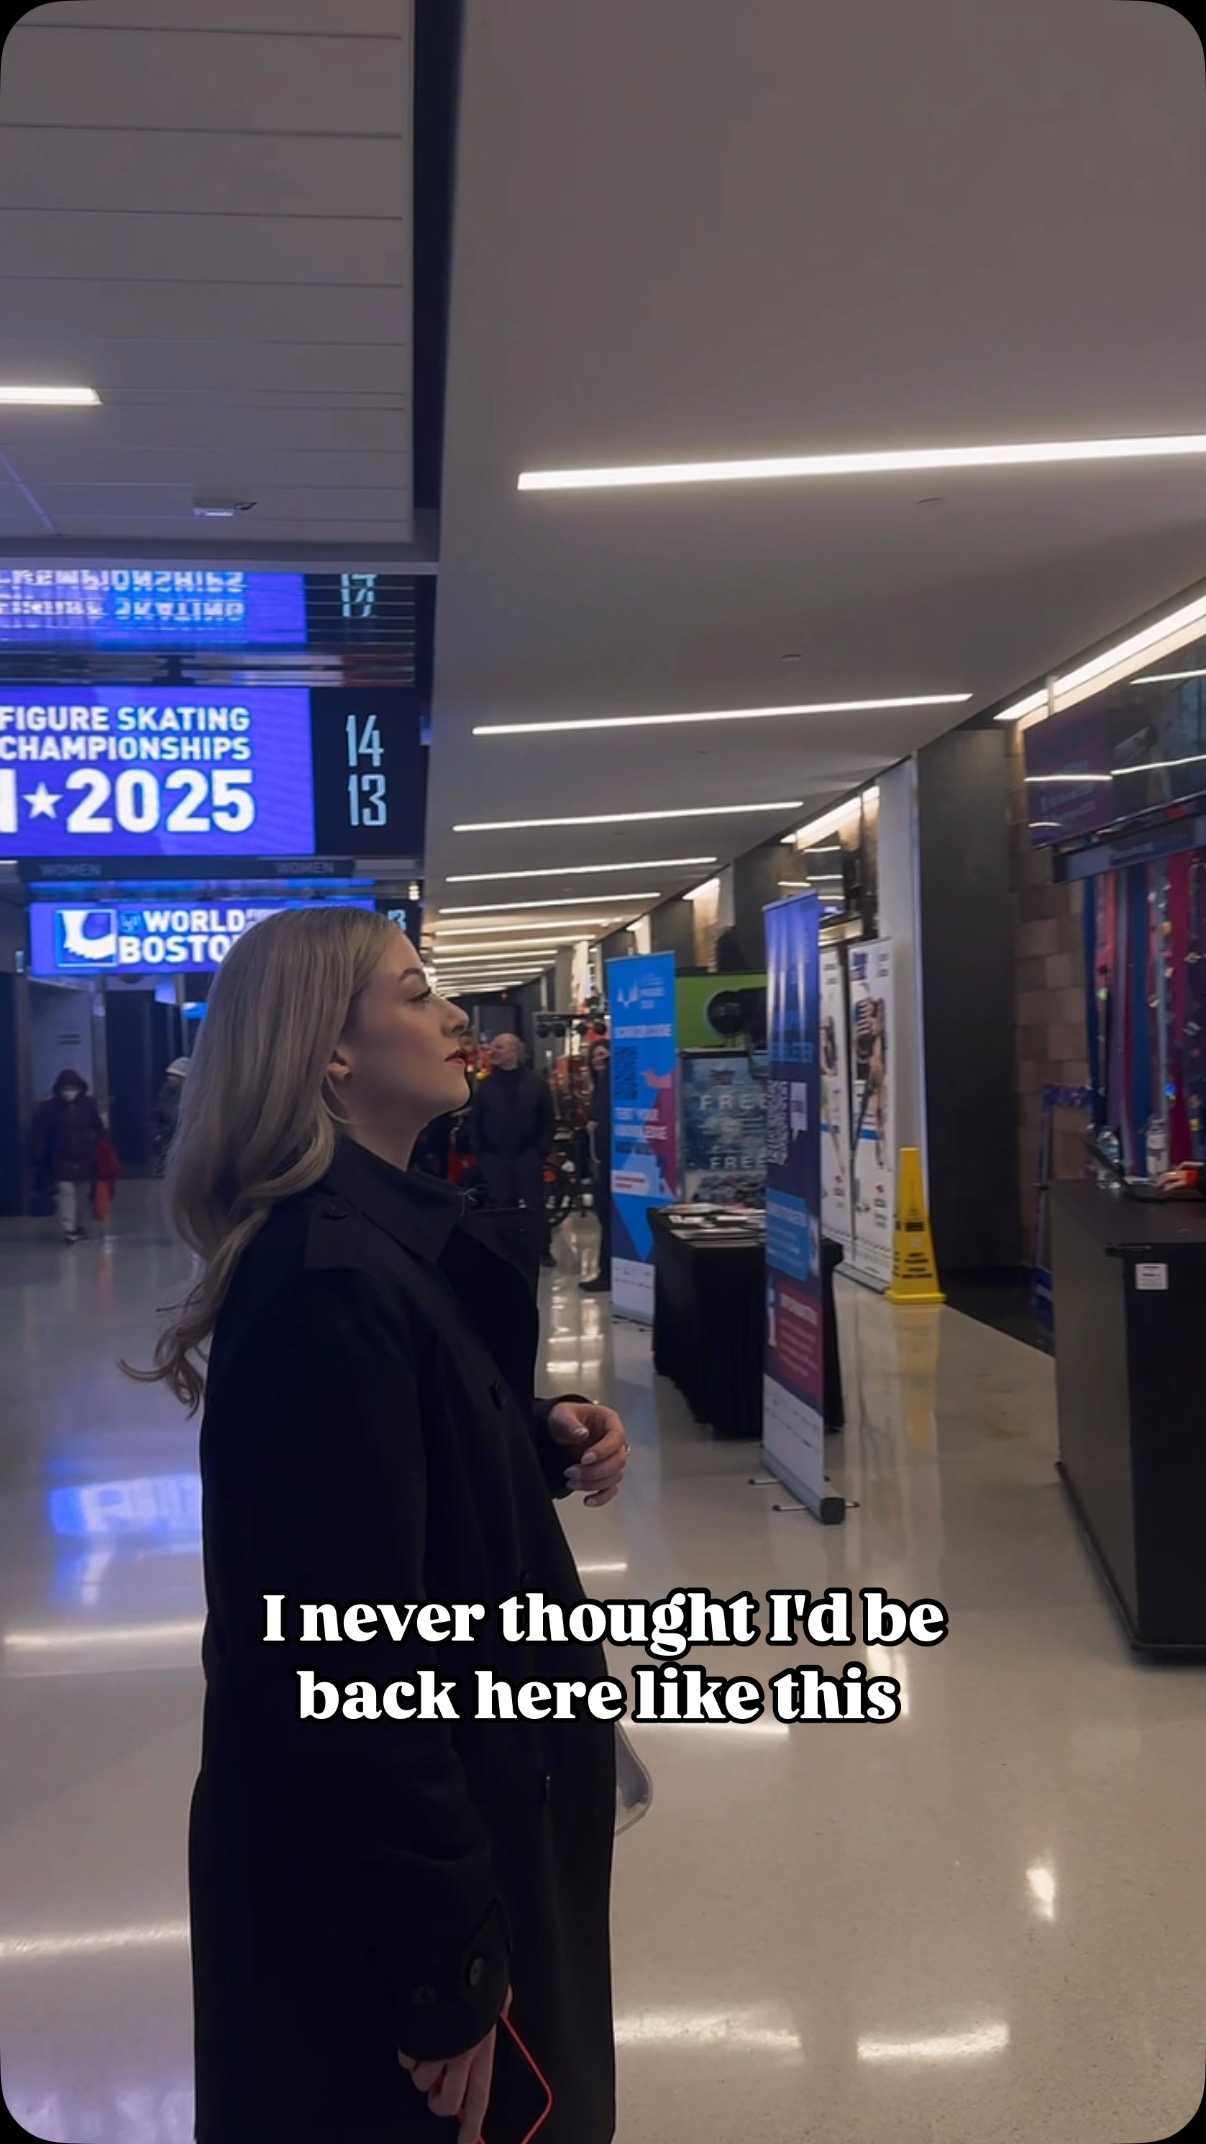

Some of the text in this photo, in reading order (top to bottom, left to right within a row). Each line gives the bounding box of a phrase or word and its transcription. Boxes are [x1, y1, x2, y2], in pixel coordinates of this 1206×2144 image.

[0, 706, 250, 731] FIGURE SKATING
[0, 735, 251, 761] CHAMPIONSHIPS
[346, 715, 384, 767] 14
[66, 768, 255, 833] 2025
[348, 774, 386, 826] 13
[40, 863, 103, 877] WOMEN
[276, 861, 335, 874] WOMEN
[142, 909, 246, 932] WORLD
[118, 935, 240, 964] BOSTO
